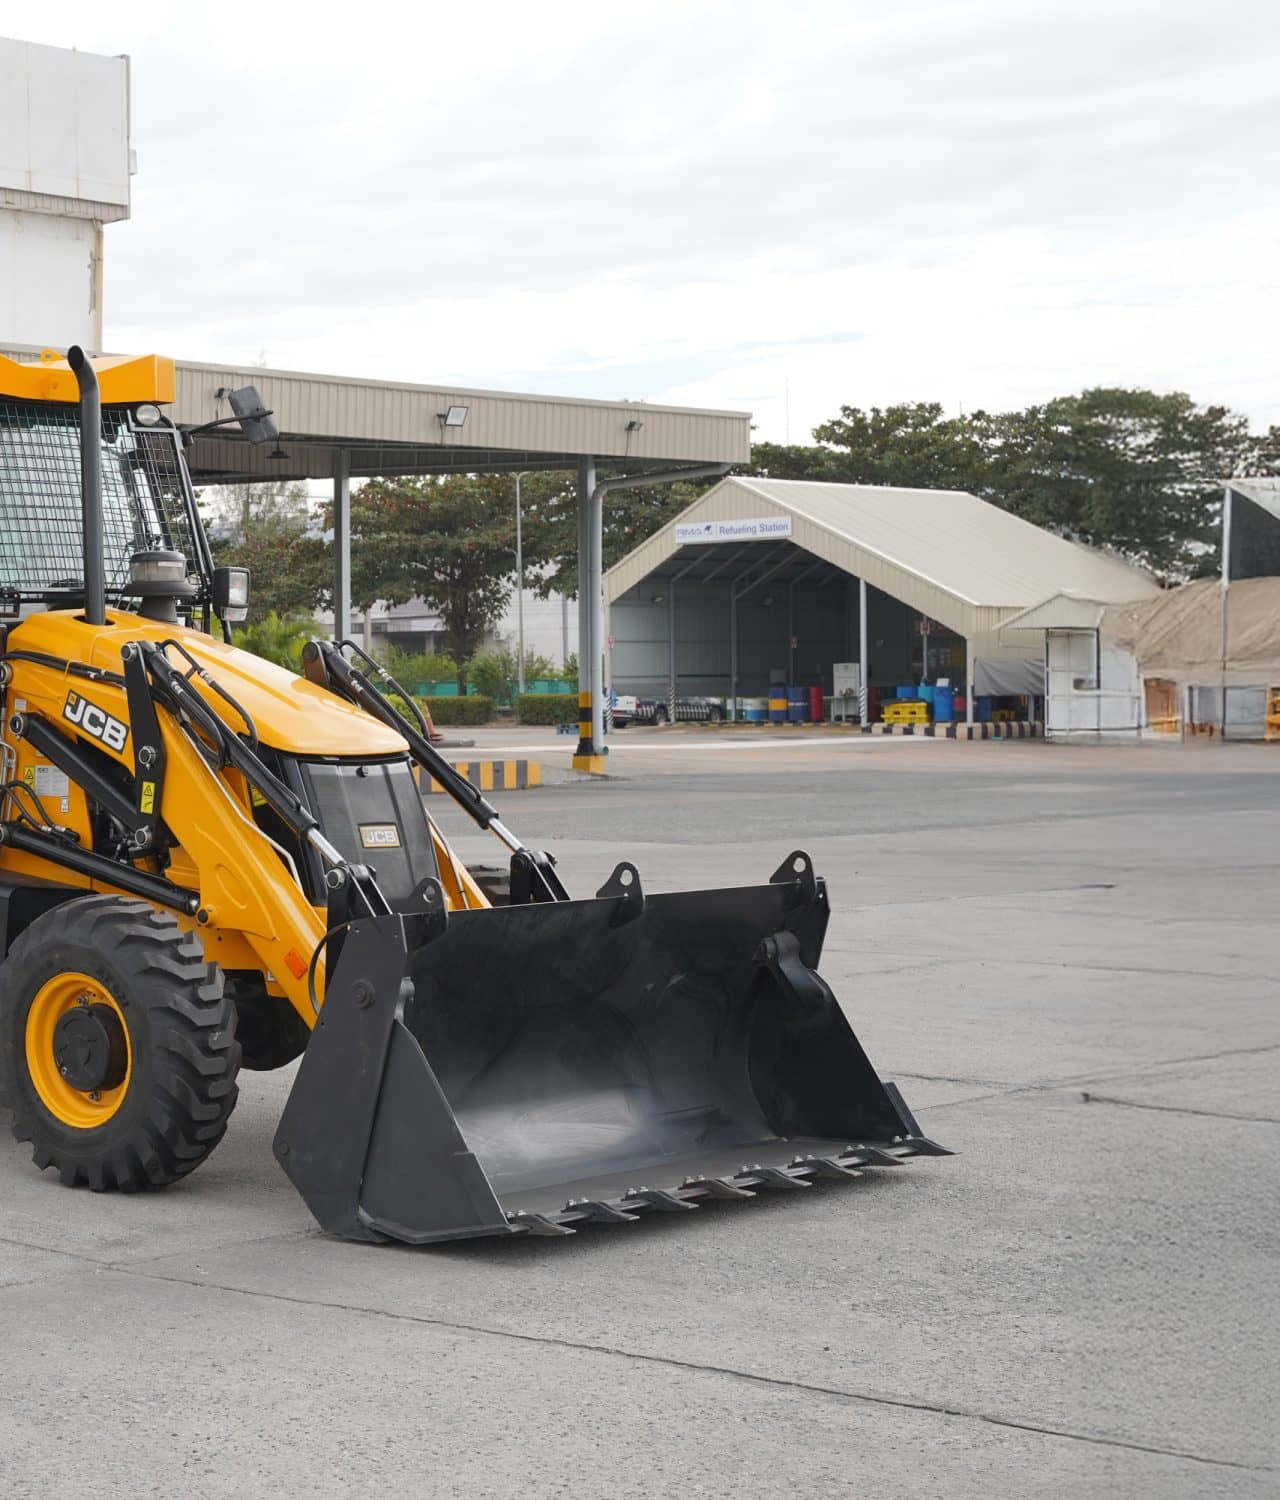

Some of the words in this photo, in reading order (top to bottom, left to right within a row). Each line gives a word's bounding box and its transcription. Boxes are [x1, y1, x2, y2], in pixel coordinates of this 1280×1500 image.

[720, 525, 757, 535] Refueling
[759, 522, 789, 533] Station
[65, 699, 127, 751] JCB
[367, 830, 396, 843] JCB
